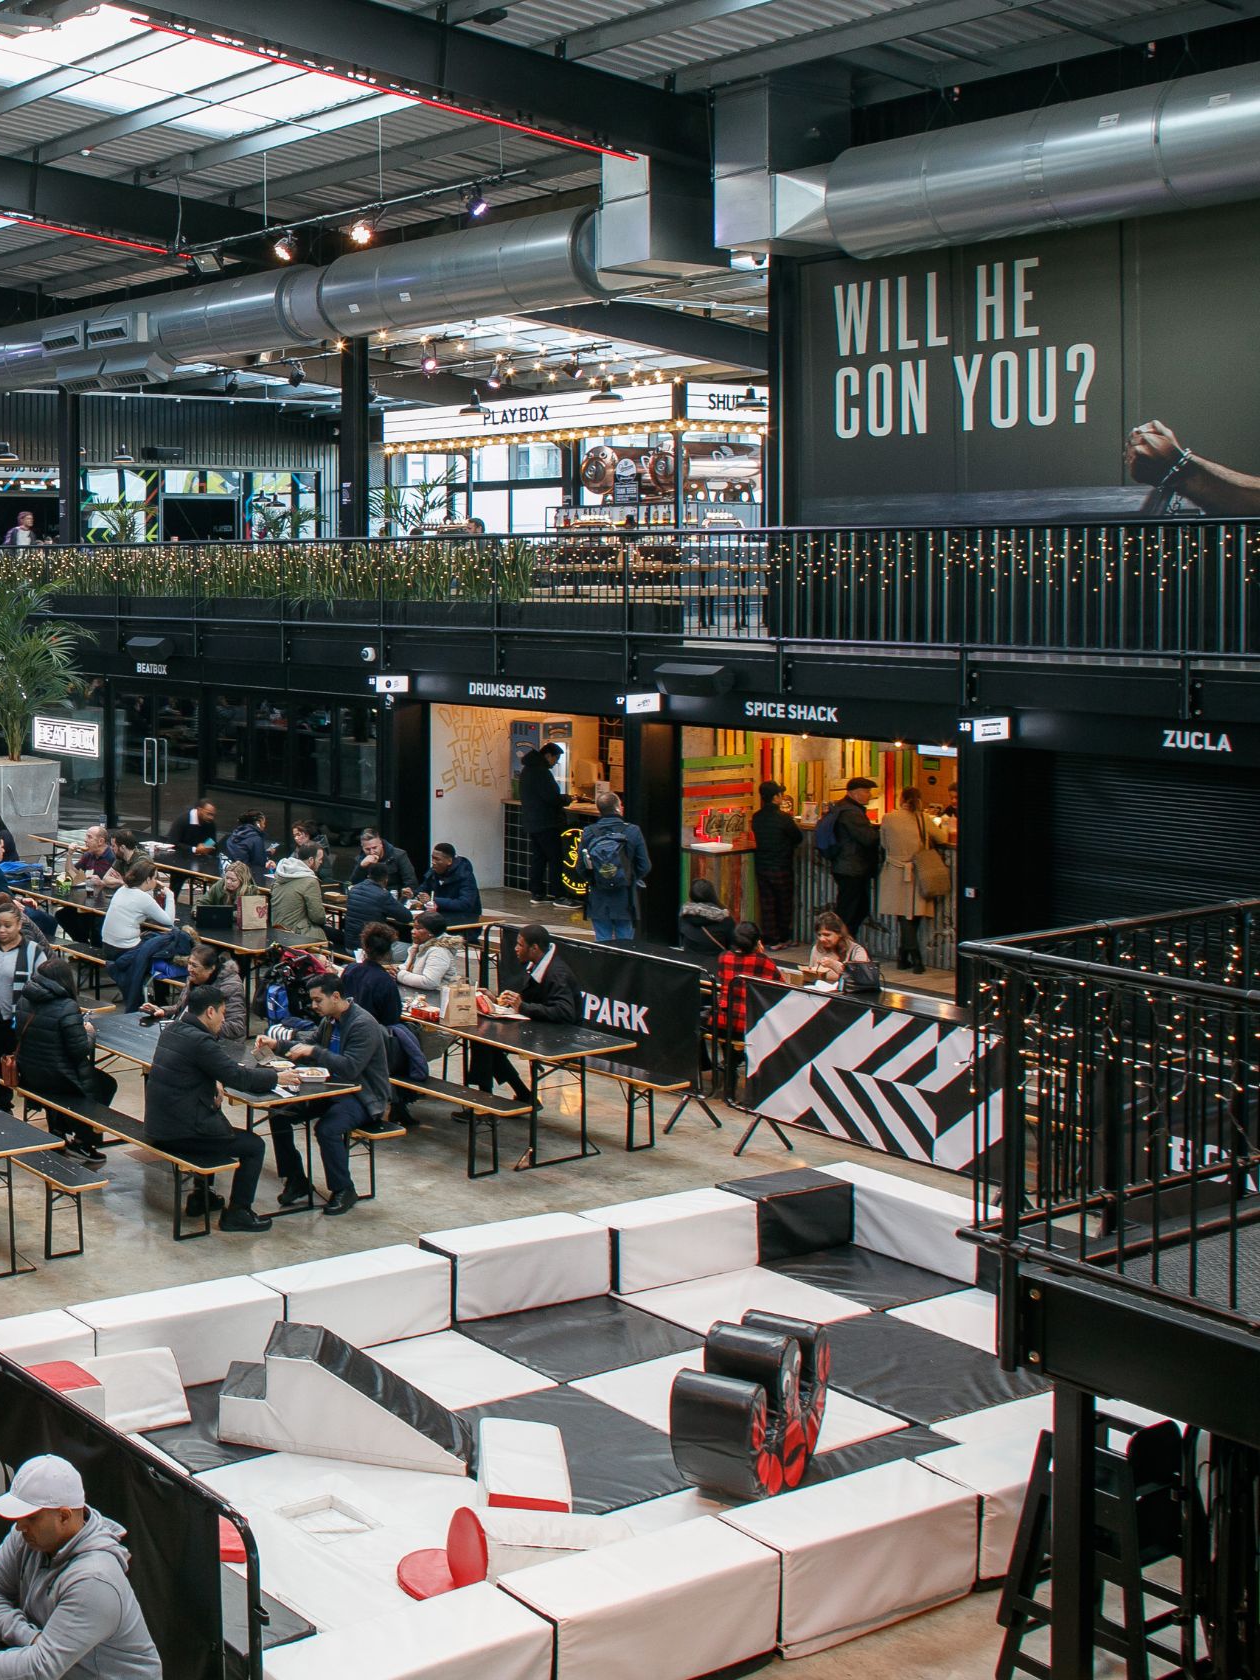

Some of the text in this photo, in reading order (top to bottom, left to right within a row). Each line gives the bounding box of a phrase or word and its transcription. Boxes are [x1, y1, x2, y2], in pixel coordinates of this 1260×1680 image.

[834, 256, 1040, 357] WILL HE
[835, 342, 1097, 440] CON YOU?
[483, 405, 550, 426] PLAYBOX
[137, 662, 168, 676] BEATBOX
[469, 682, 546, 700] DRUMS&FLATS
[616, 696, 625, 705] 17
[745, 701, 839, 723] SPICE SHACK
[39, 724, 66, 747] BEAT
[1162, 729, 1232, 752] ZUCLA
